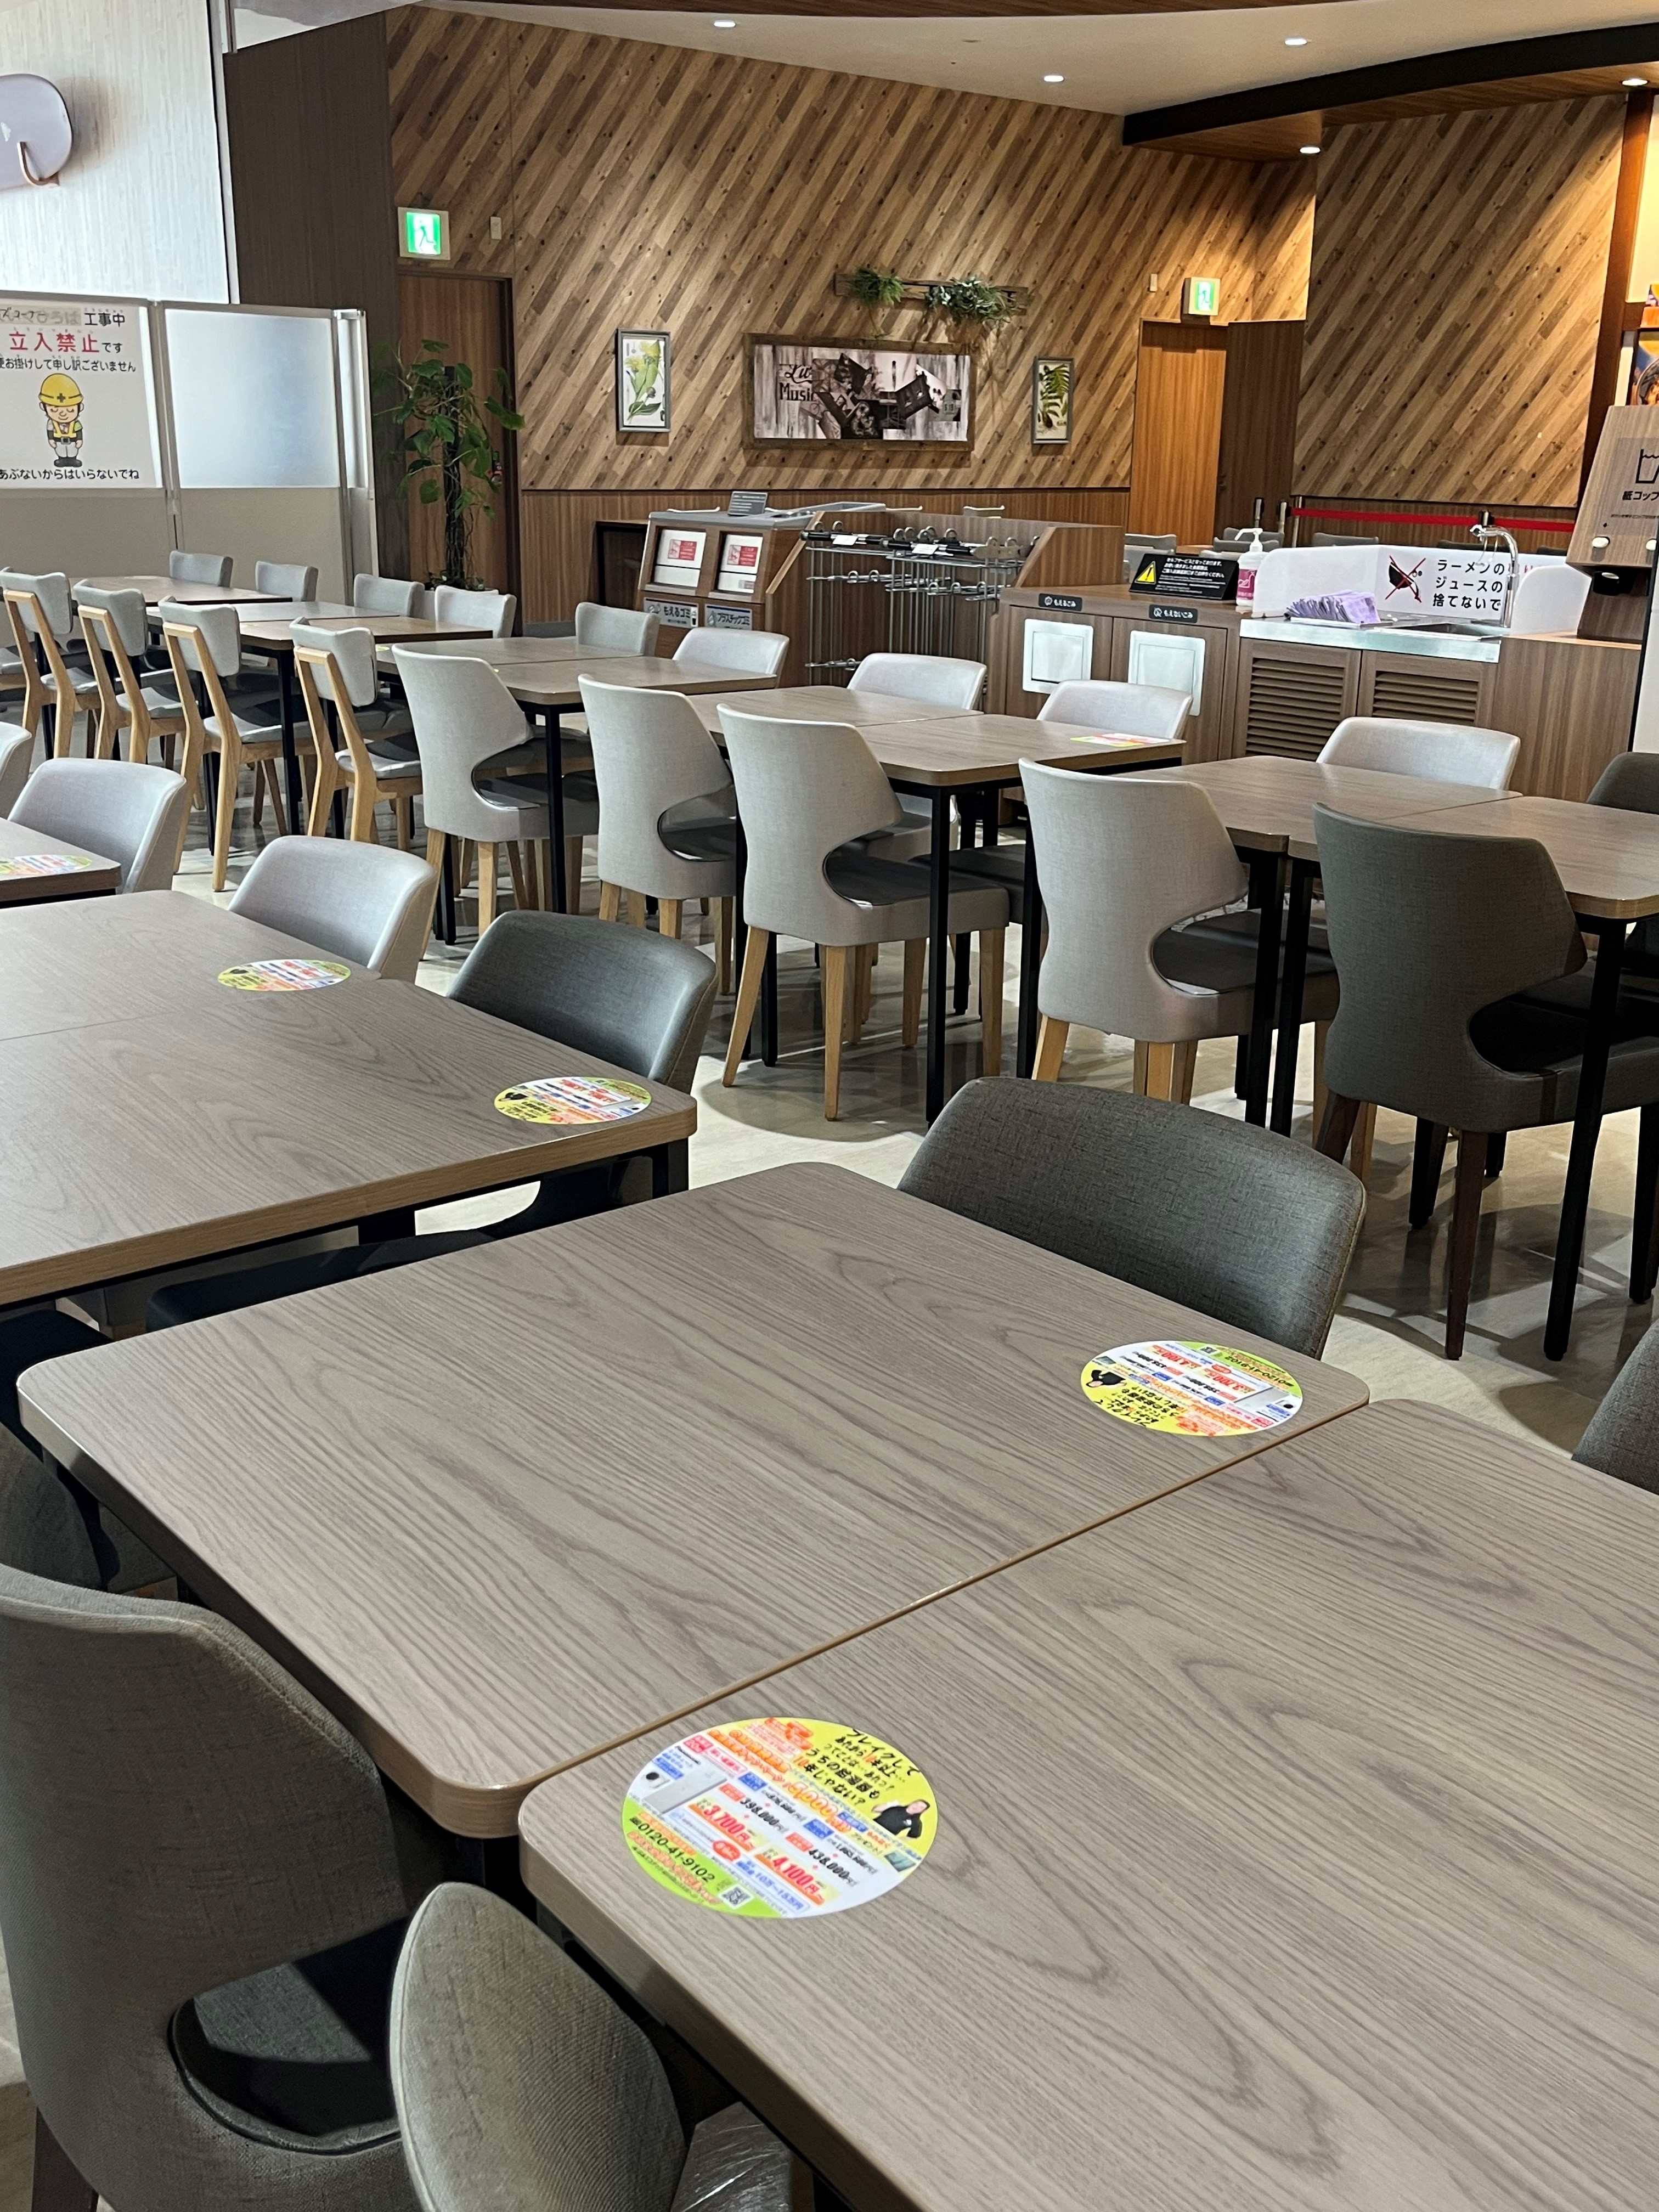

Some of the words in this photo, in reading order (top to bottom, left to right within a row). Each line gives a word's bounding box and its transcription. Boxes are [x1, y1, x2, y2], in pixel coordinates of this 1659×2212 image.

[84, 312, 125, 328] 工事中
[9, 331, 123, 353] 立入禁止です
[0, 469, 140, 480] あぶないからはいらないでね
[1436, 576, 1503, 593] ジュースの
[1432, 593, 1501, 611] 捨てないで
[637, 1822, 715, 1883] 0120-41-9102
